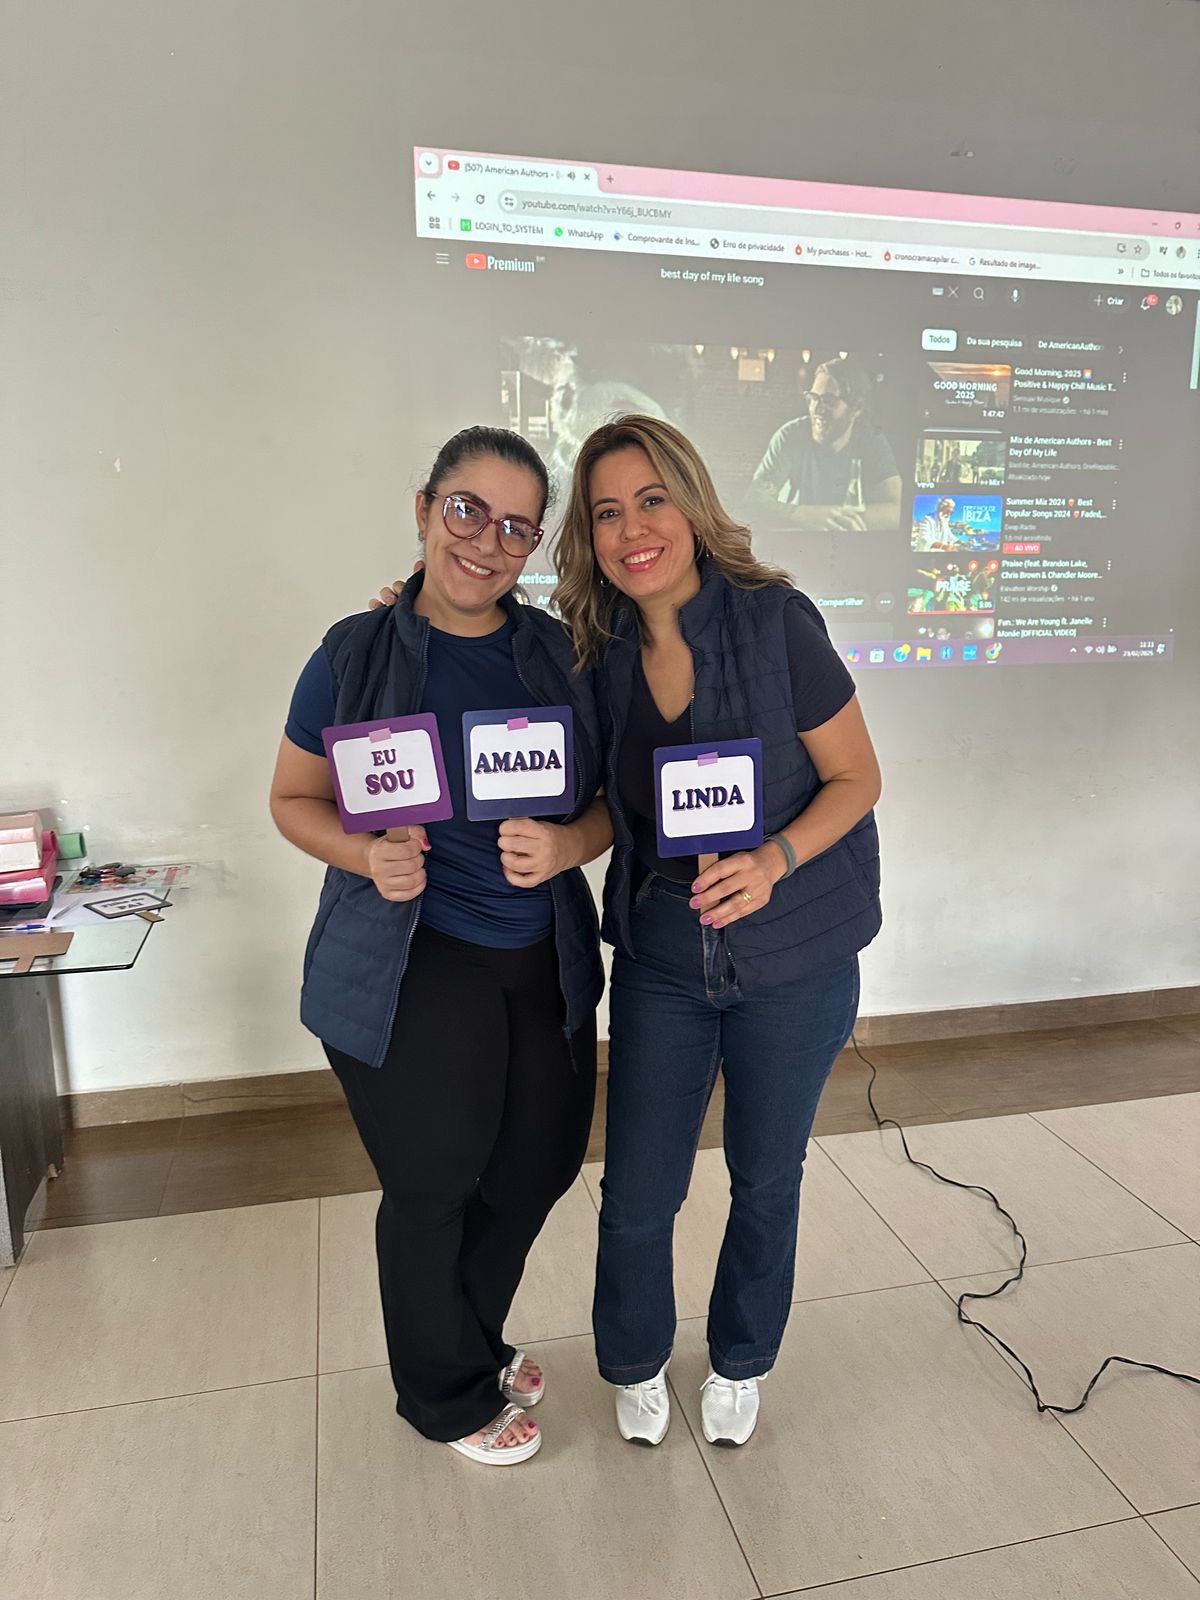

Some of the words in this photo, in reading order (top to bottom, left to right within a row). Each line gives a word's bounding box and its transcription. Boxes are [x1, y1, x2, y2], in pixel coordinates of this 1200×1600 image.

[465, 163, 484, 173] (507)
[485, 165, 519, 176] American
[520, 168, 549, 178] Authors
[475, 221, 544, 236] LOGIN_TO_SYSTEM
[568, 229, 604, 241] WhatsApp
[628, 233, 673, 244] Comprovante
[748, 242, 784, 252] privacidade
[807, 247, 816, 255] My
[818, 248, 850, 256] purchases
[487, 255, 535, 272] Premium
[980, 258, 1008, 267] Resultado
[1010, 260, 1017, 268] de
[661, 269, 680, 280] best
[682, 270, 699, 282] day
[701, 271, 710, 281] of
[711, 273, 726, 284] my
[727, 272, 741, 283] life
[743, 275, 764, 286] song
[1154, 270, 1169, 278] Todos
[1107, 296, 1124, 305] Criar
[929, 335, 950, 344] Todos
[967, 337, 977, 345] Da
[992, 338, 1023, 348] pesquisa
[1015, 367, 1033, 376] Good
[1034, 368, 1062, 378] Morning,
[1064, 370, 1081, 378] 2025
[934, 381, 958, 390] GOOD
[959, 382, 998, 392] MORNING
[1014, 380, 1041, 388] Positive
[1042, 381, 1048, 389] &
[1049, 381, 1069, 391] Happy
[1071, 382, 1085, 390] Chill
[1086, 382, 1107, 391] Music
[955, 390, 975, 399] 2025
[1024, 436, 1032, 444] de
[1033, 437, 1065, 445] American
[1066, 437, 1091, 446] Authors
[1097, 438, 1112, 446] Best
[1009, 448, 1022, 457] Day
[1023, 448, 1031, 456] Of
[1033, 449, 1043, 458] My
[1006, 498, 1034, 506] Summer
[1035, 498, 1047, 506] Mix
[1049, 498, 1065, 506] 2024
[963, 511, 991, 522] IBIZA
[1005, 509, 1031, 519] Popular
[1032, 510, 1053, 519] Songs
[1054, 510, 1071, 518] 2024
[1002, 560, 1023, 568] Praise
[1070, 560, 1088, 568] Lake,
[936, 580, 972, 592] PRAISE
[817, 597, 864, 608] Compartilhar
[1040, 618, 1060, 627] Young
[371, 749, 397, 766] EU
[474, 748, 562, 774] AMADA
[366, 768, 415, 796] SOU
[672, 785, 745, 811] LINDA
